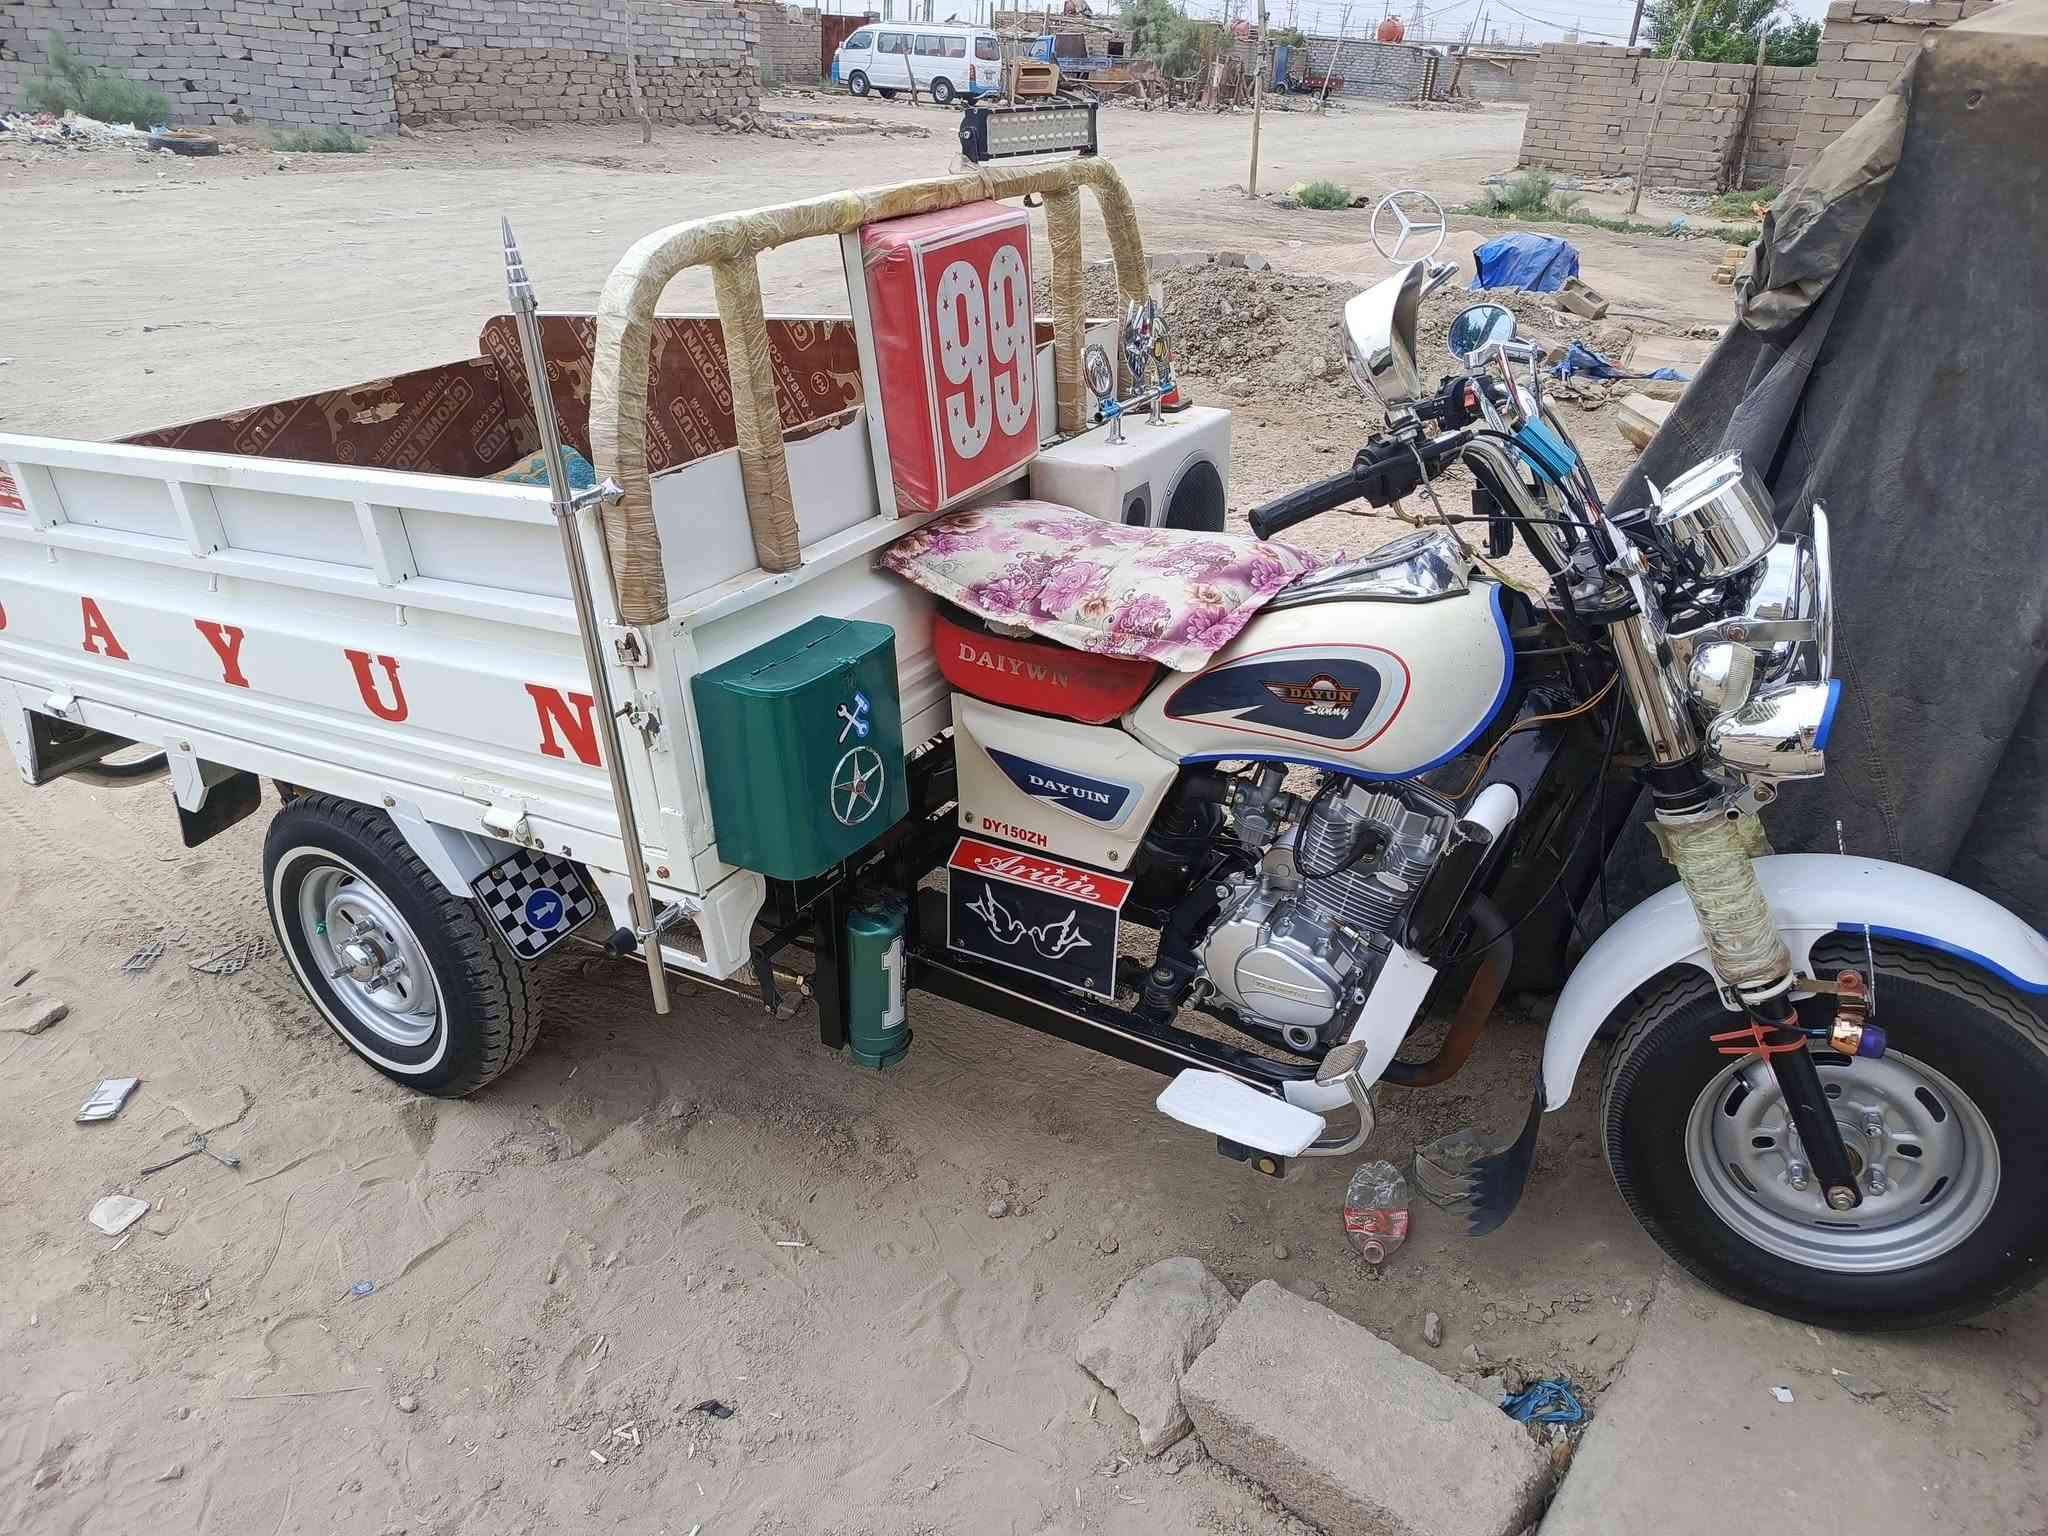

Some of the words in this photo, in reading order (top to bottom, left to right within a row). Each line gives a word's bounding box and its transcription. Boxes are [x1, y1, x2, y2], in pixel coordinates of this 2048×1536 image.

[936, 244, 1034, 459] 99
[1303, 704, 1350, 720] Sunny
[1028, 774, 1110, 804] DAYUIN
[982, 817, 1048, 847] DY150ZH
[974, 855, 1101, 900] Arian
[881, 934, 907, 1030] 1
